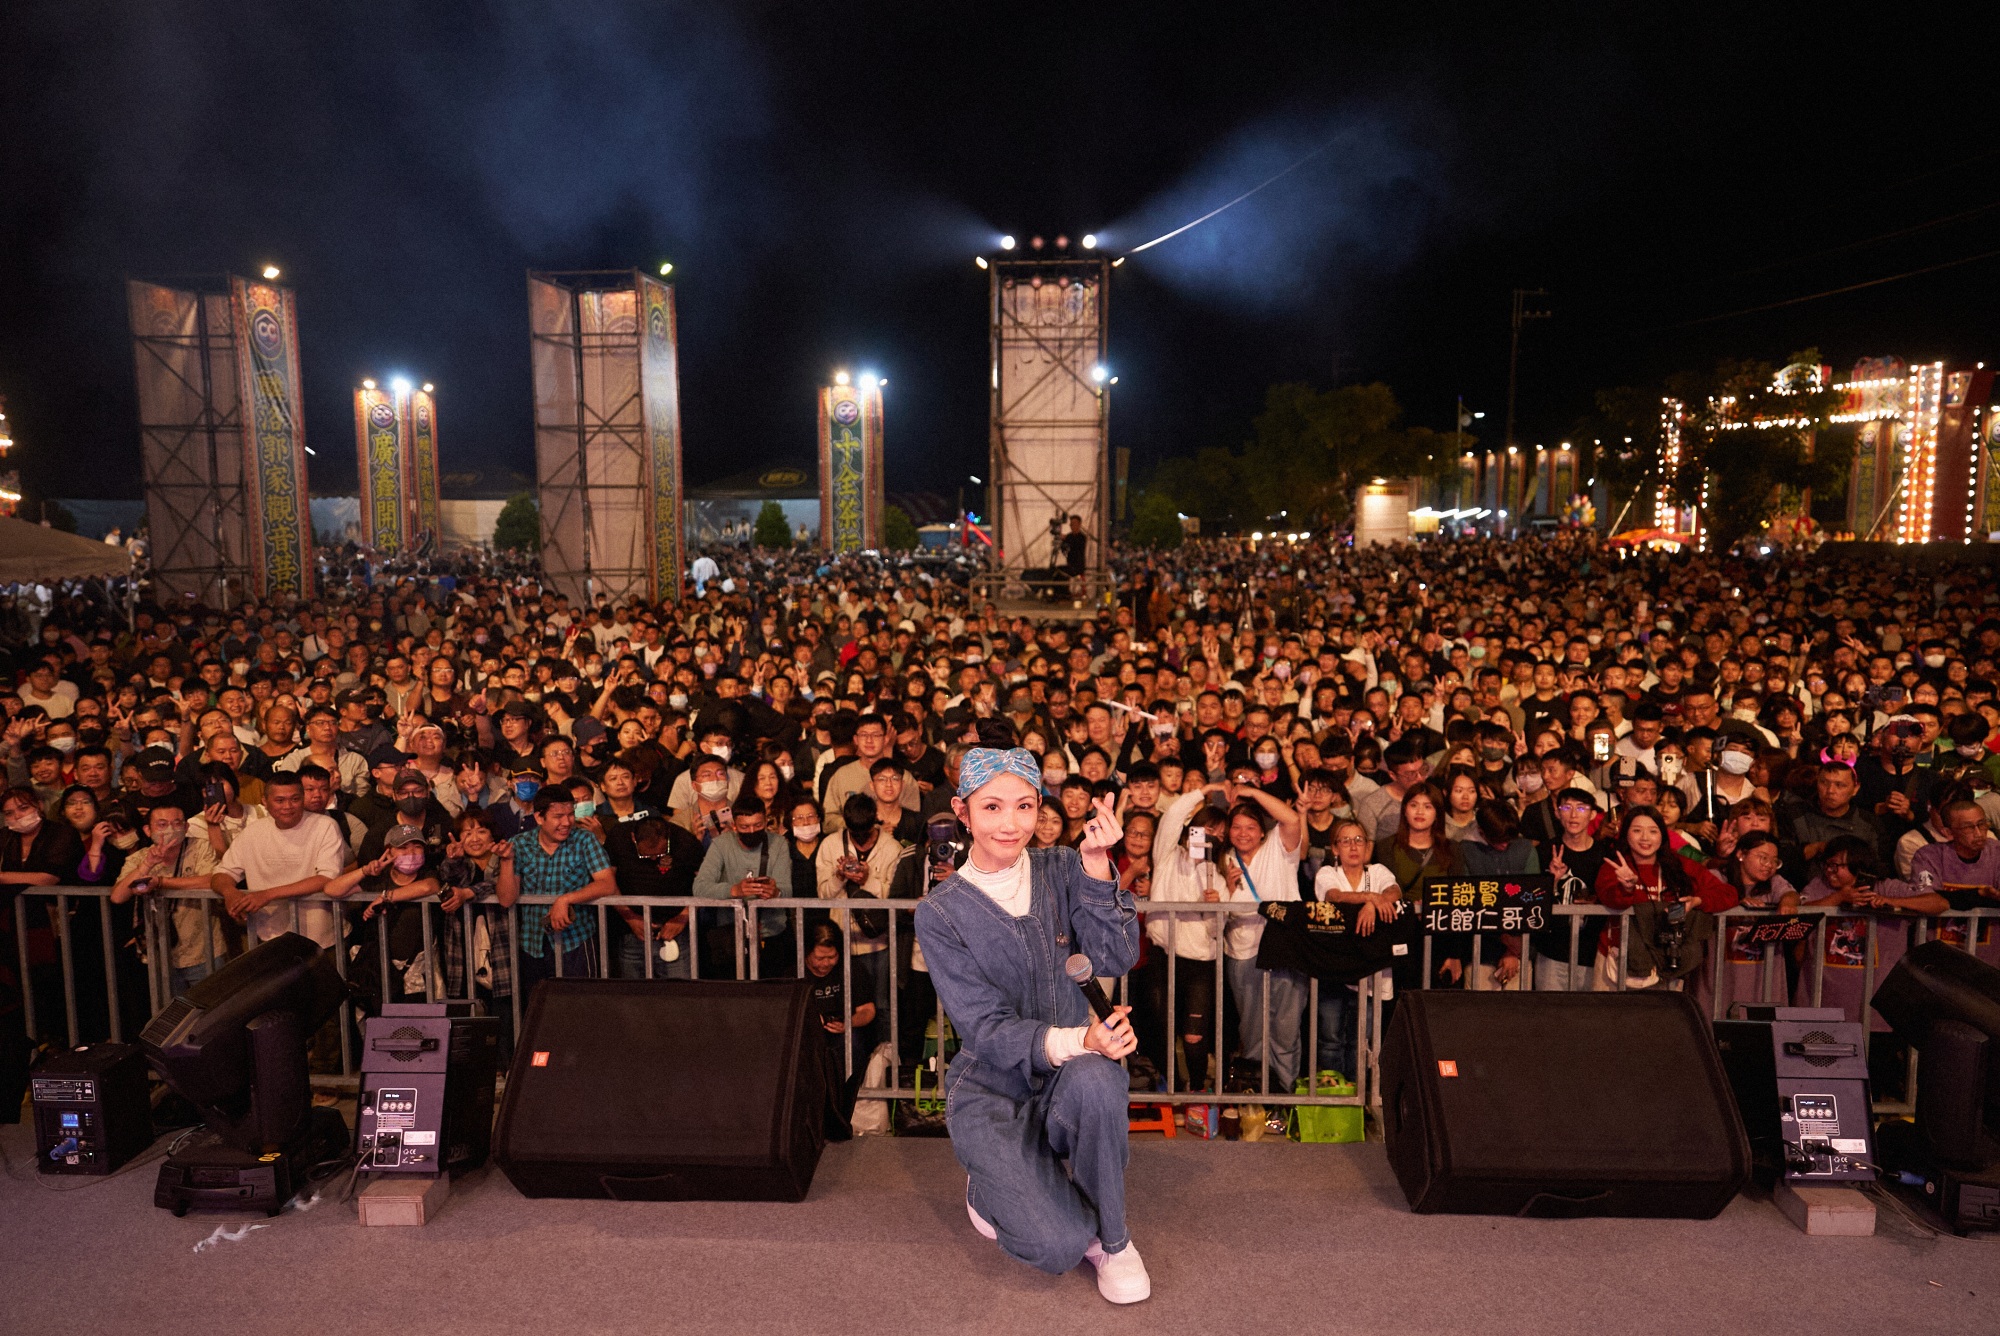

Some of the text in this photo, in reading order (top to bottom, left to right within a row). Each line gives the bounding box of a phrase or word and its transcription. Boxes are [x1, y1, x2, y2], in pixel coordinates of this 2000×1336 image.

[255, 374, 297, 592] 洛郭家觀音菩
[1429, 880, 1500, 907] 王識賢
[1425, 907, 1524, 932] 北館仁哥
